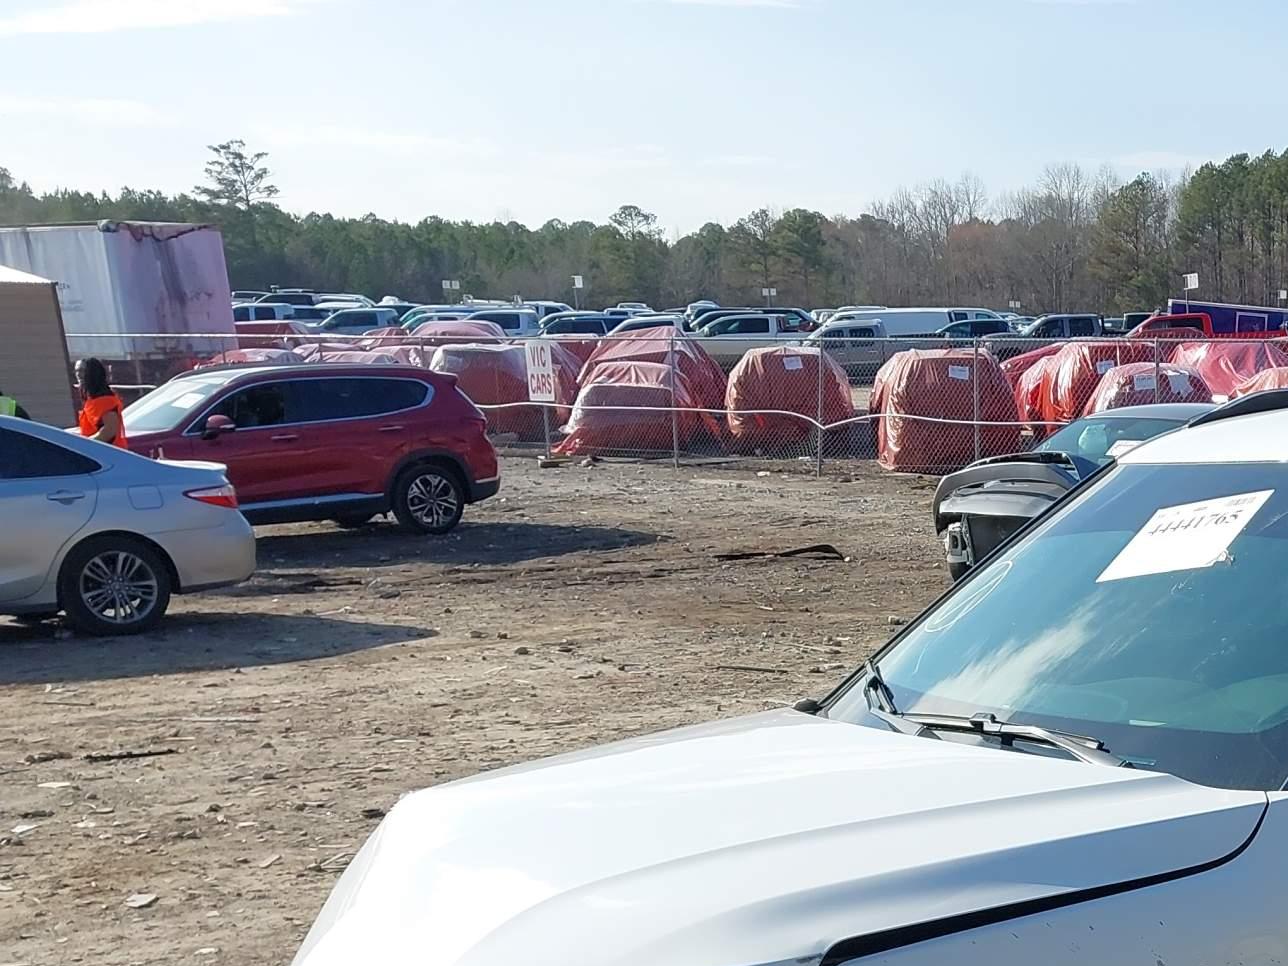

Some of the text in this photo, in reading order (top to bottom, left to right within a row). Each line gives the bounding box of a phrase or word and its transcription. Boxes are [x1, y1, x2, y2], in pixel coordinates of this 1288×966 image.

[530, 345, 547, 367] VIC
[531, 373, 553, 395] CARS
[1149, 509, 1243, 535] 44441765
